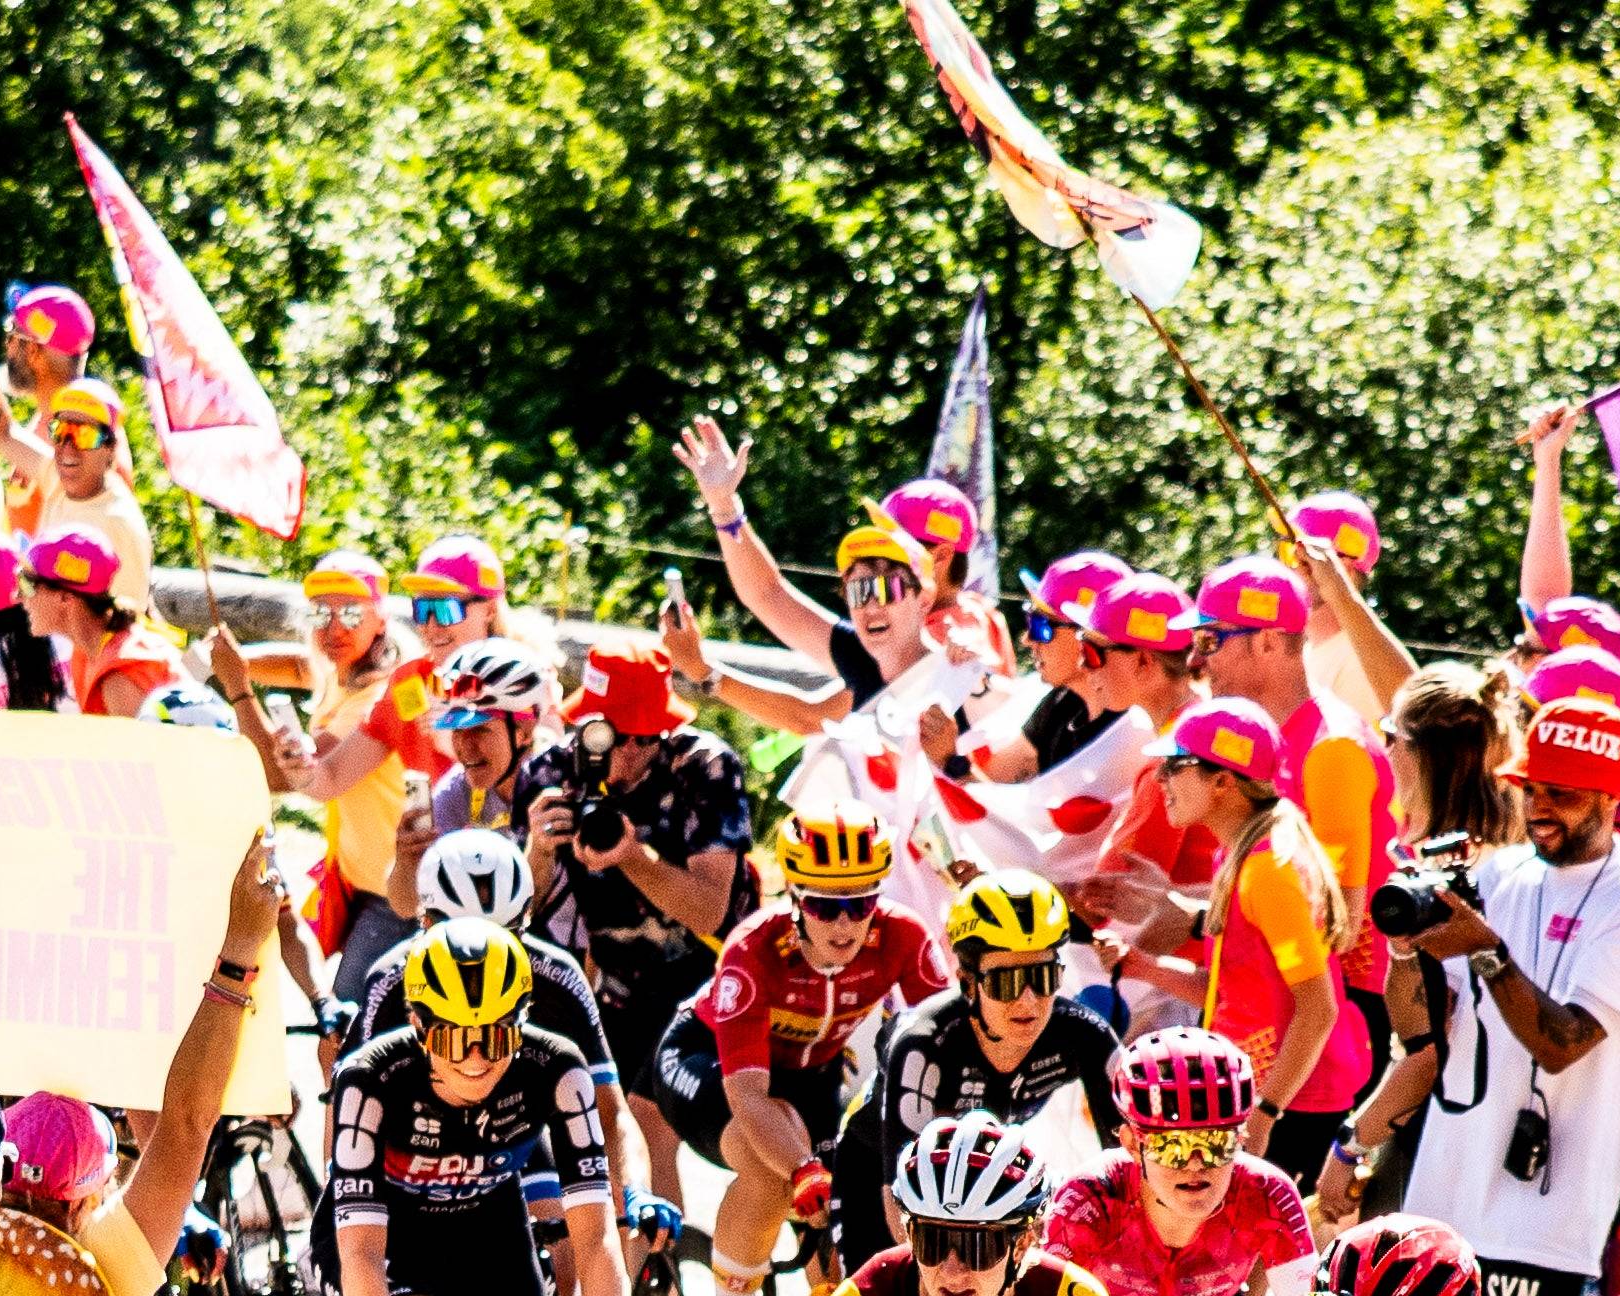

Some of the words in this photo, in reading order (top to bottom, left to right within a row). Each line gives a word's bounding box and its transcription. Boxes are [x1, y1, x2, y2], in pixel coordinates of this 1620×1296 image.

[407, 1155, 485, 1176] FDJ
[577, 1156, 609, 1177] ga
[333, 1177, 374, 1200] gan
